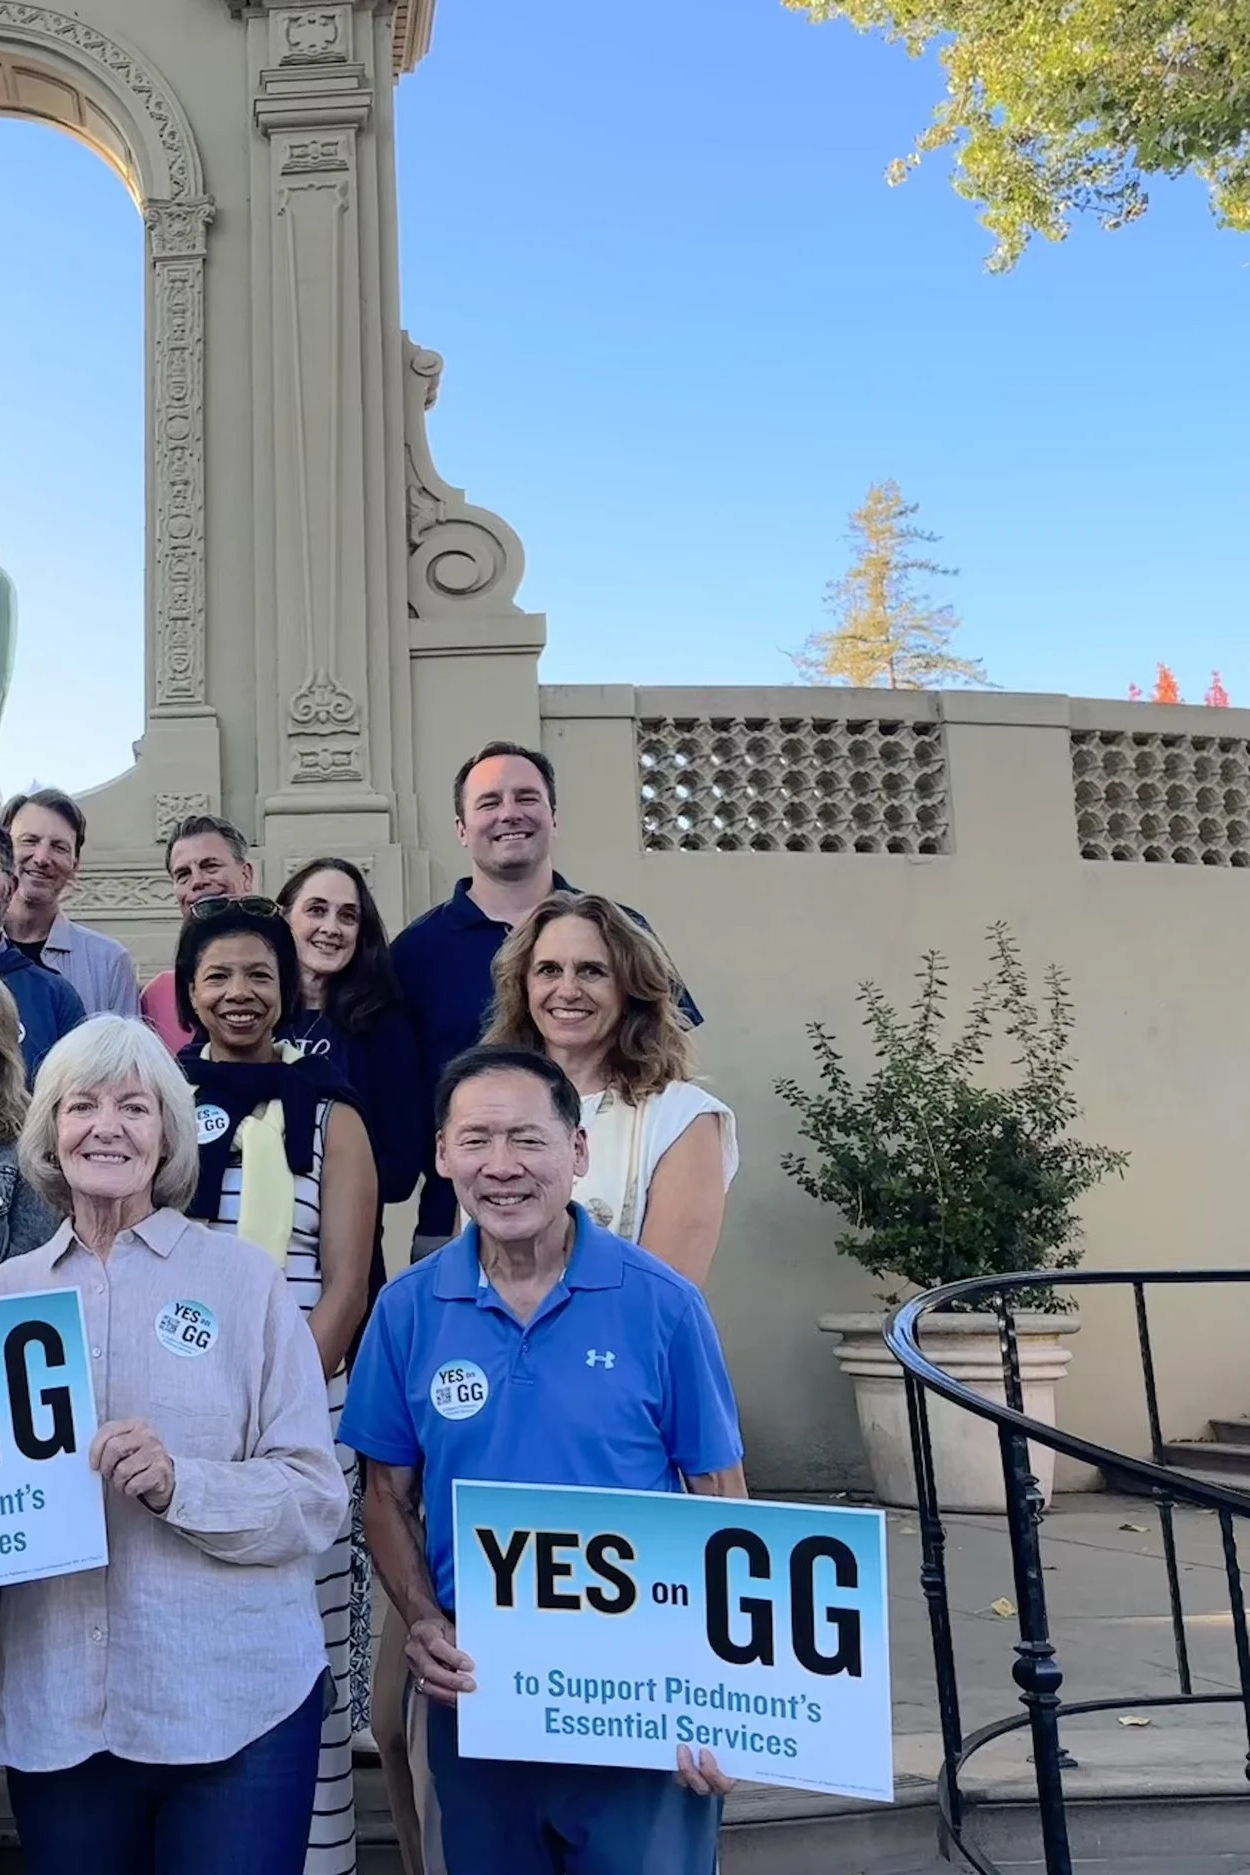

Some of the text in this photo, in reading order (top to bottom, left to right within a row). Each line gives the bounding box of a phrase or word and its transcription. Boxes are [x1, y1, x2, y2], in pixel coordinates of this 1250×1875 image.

[204, 1117, 225, 1131] GG
[174, 1303, 201, 1323] YES
[182, 1325, 211, 1349] GG
[439, 1368, 464, 1384] YES
[457, 1383, 483, 1402] GG
[475, 1527, 862, 1678] YES on GG
[513, 1669, 822, 1723] to Support Piedmont's
[545, 1707, 798, 1758] Essential Services
